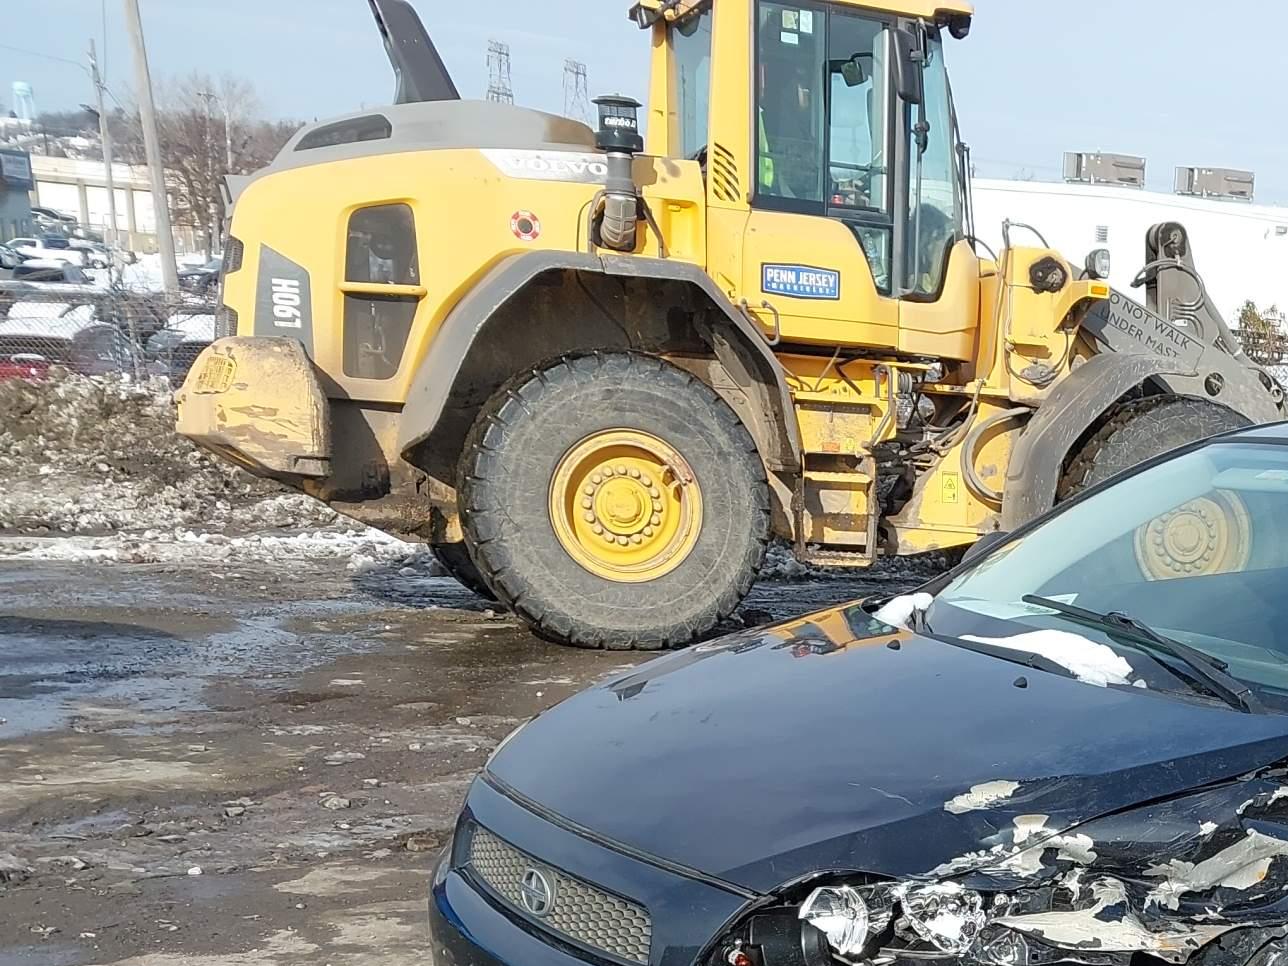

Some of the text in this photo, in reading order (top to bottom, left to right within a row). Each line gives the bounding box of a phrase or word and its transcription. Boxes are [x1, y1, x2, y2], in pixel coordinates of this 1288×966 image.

[503, 156, 608, 176] VOLVO
[766, 268, 835, 287] PENN JERSEY
[271, 277, 302, 328] L90H
[1121, 300, 1153, 324] NOT
[1154, 318, 1190, 350] WALK
[1145, 335, 1181, 358] MAST
